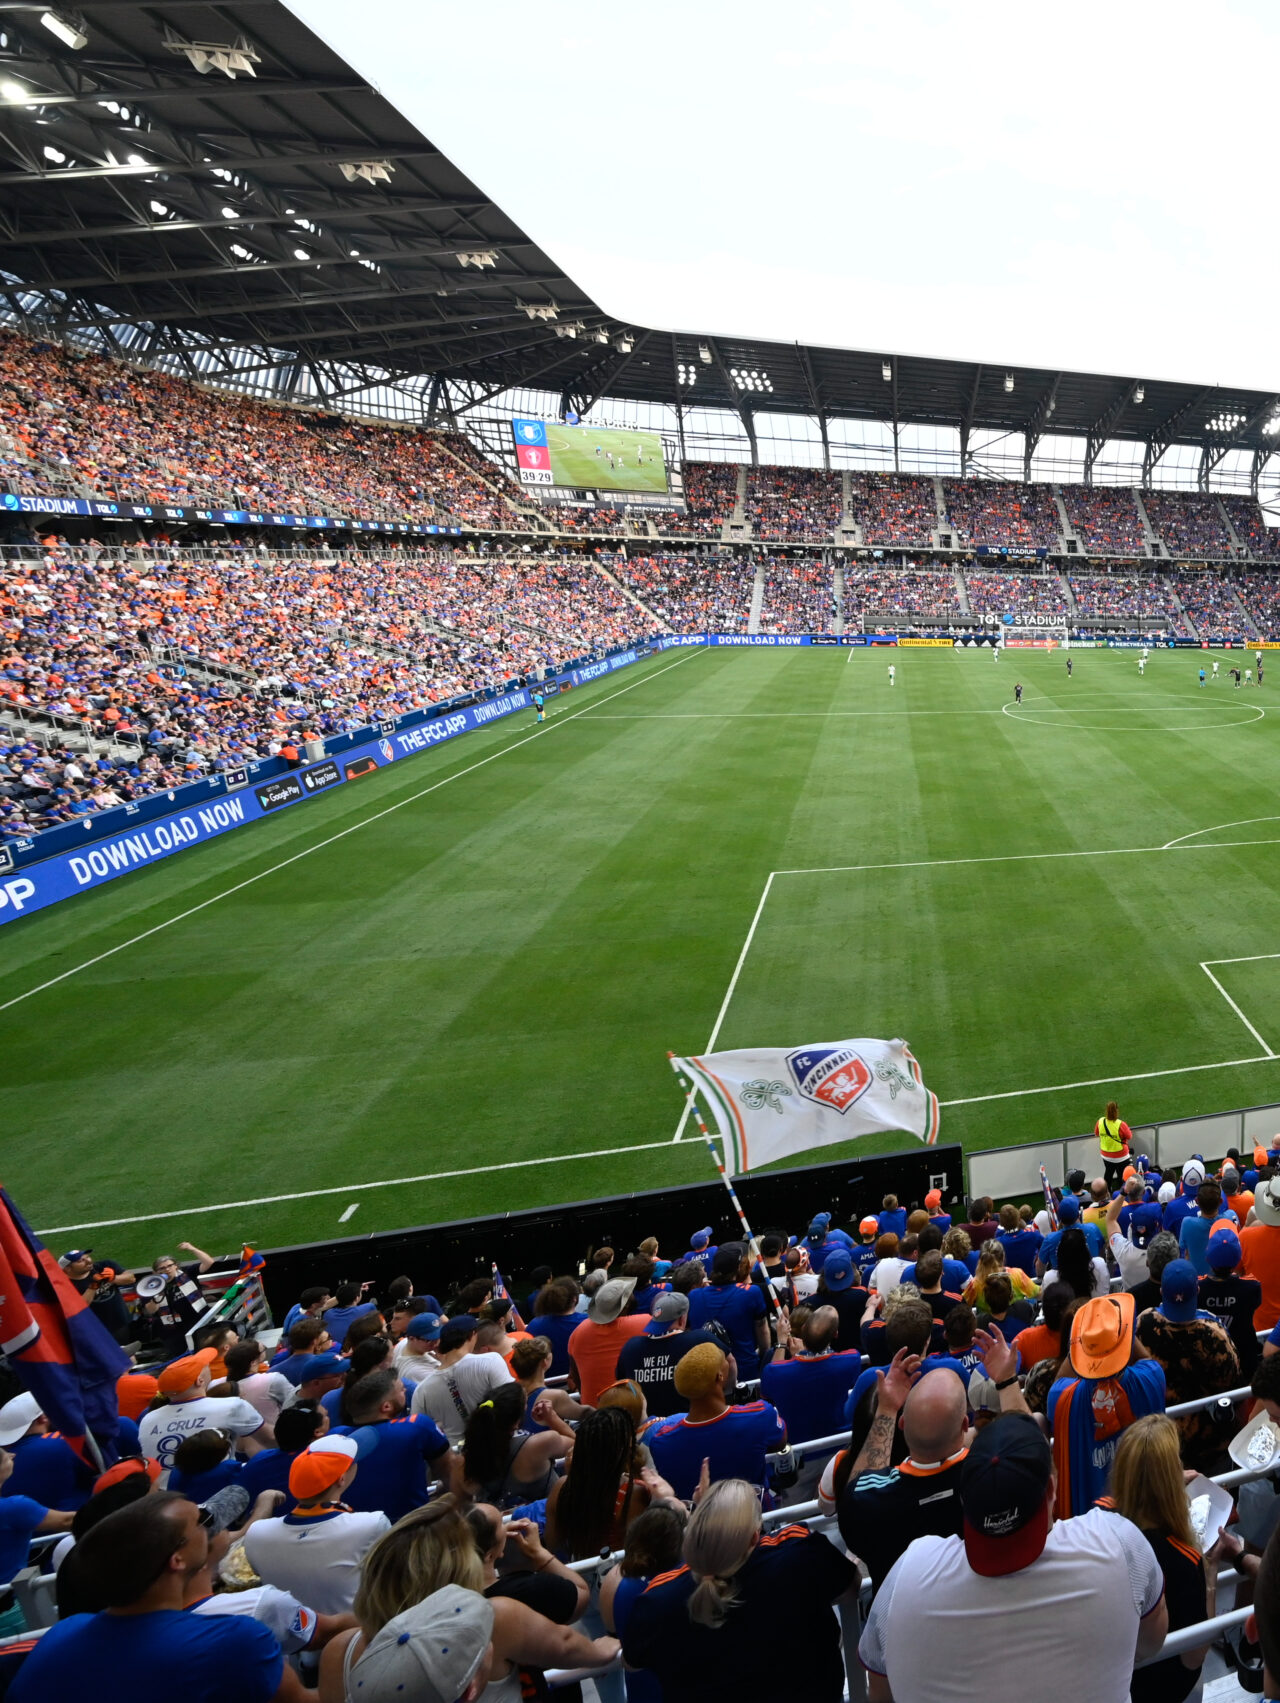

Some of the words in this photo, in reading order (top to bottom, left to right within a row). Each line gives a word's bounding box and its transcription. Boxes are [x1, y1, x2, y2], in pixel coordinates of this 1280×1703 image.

[522, 471, 551, 482] 39:29
[20, 497, 78, 514] STADIUM
[633, 505, 675, 513] MERCYHEALTH
[978, 614, 1001, 625] TQL
[1014, 615, 1066, 626] STADIUM
[681, 636, 705, 645] APP
[718, 635, 776, 645] DOWNLOAD
[779, 635, 801, 645] NOW
[899, 639, 933, 647] Continental
[1061, 640, 1096, 648] Heineken
[474, 697, 511, 723] DOWNLOAD
[510, 692, 526, 708] NOW
[397, 731, 426, 752] THE
[422, 721, 448, 743] FCC
[448, 714, 467, 734] APP
[315, 776, 327, 786] App
[327, 771, 337, 781] Store
[269, 788, 288, 802] Google
[287, 785, 300, 798] Play
[68, 816, 199, 885] DOWNLOAD
[199, 798, 245, 833] NOW
[796, 1057, 812, 1070] FC
[1206, 1296, 1236, 1307] CLIP
[643, 1356, 656, 1368] WE
[656, 1355, 670, 1367] FLY
[633, 1366, 677, 1383] TOGETHE
[150, 1425, 162, 1436] A.
[166, 1417, 206, 1433] CRUZ
[983, 1506, 1020, 1529] Herschel
